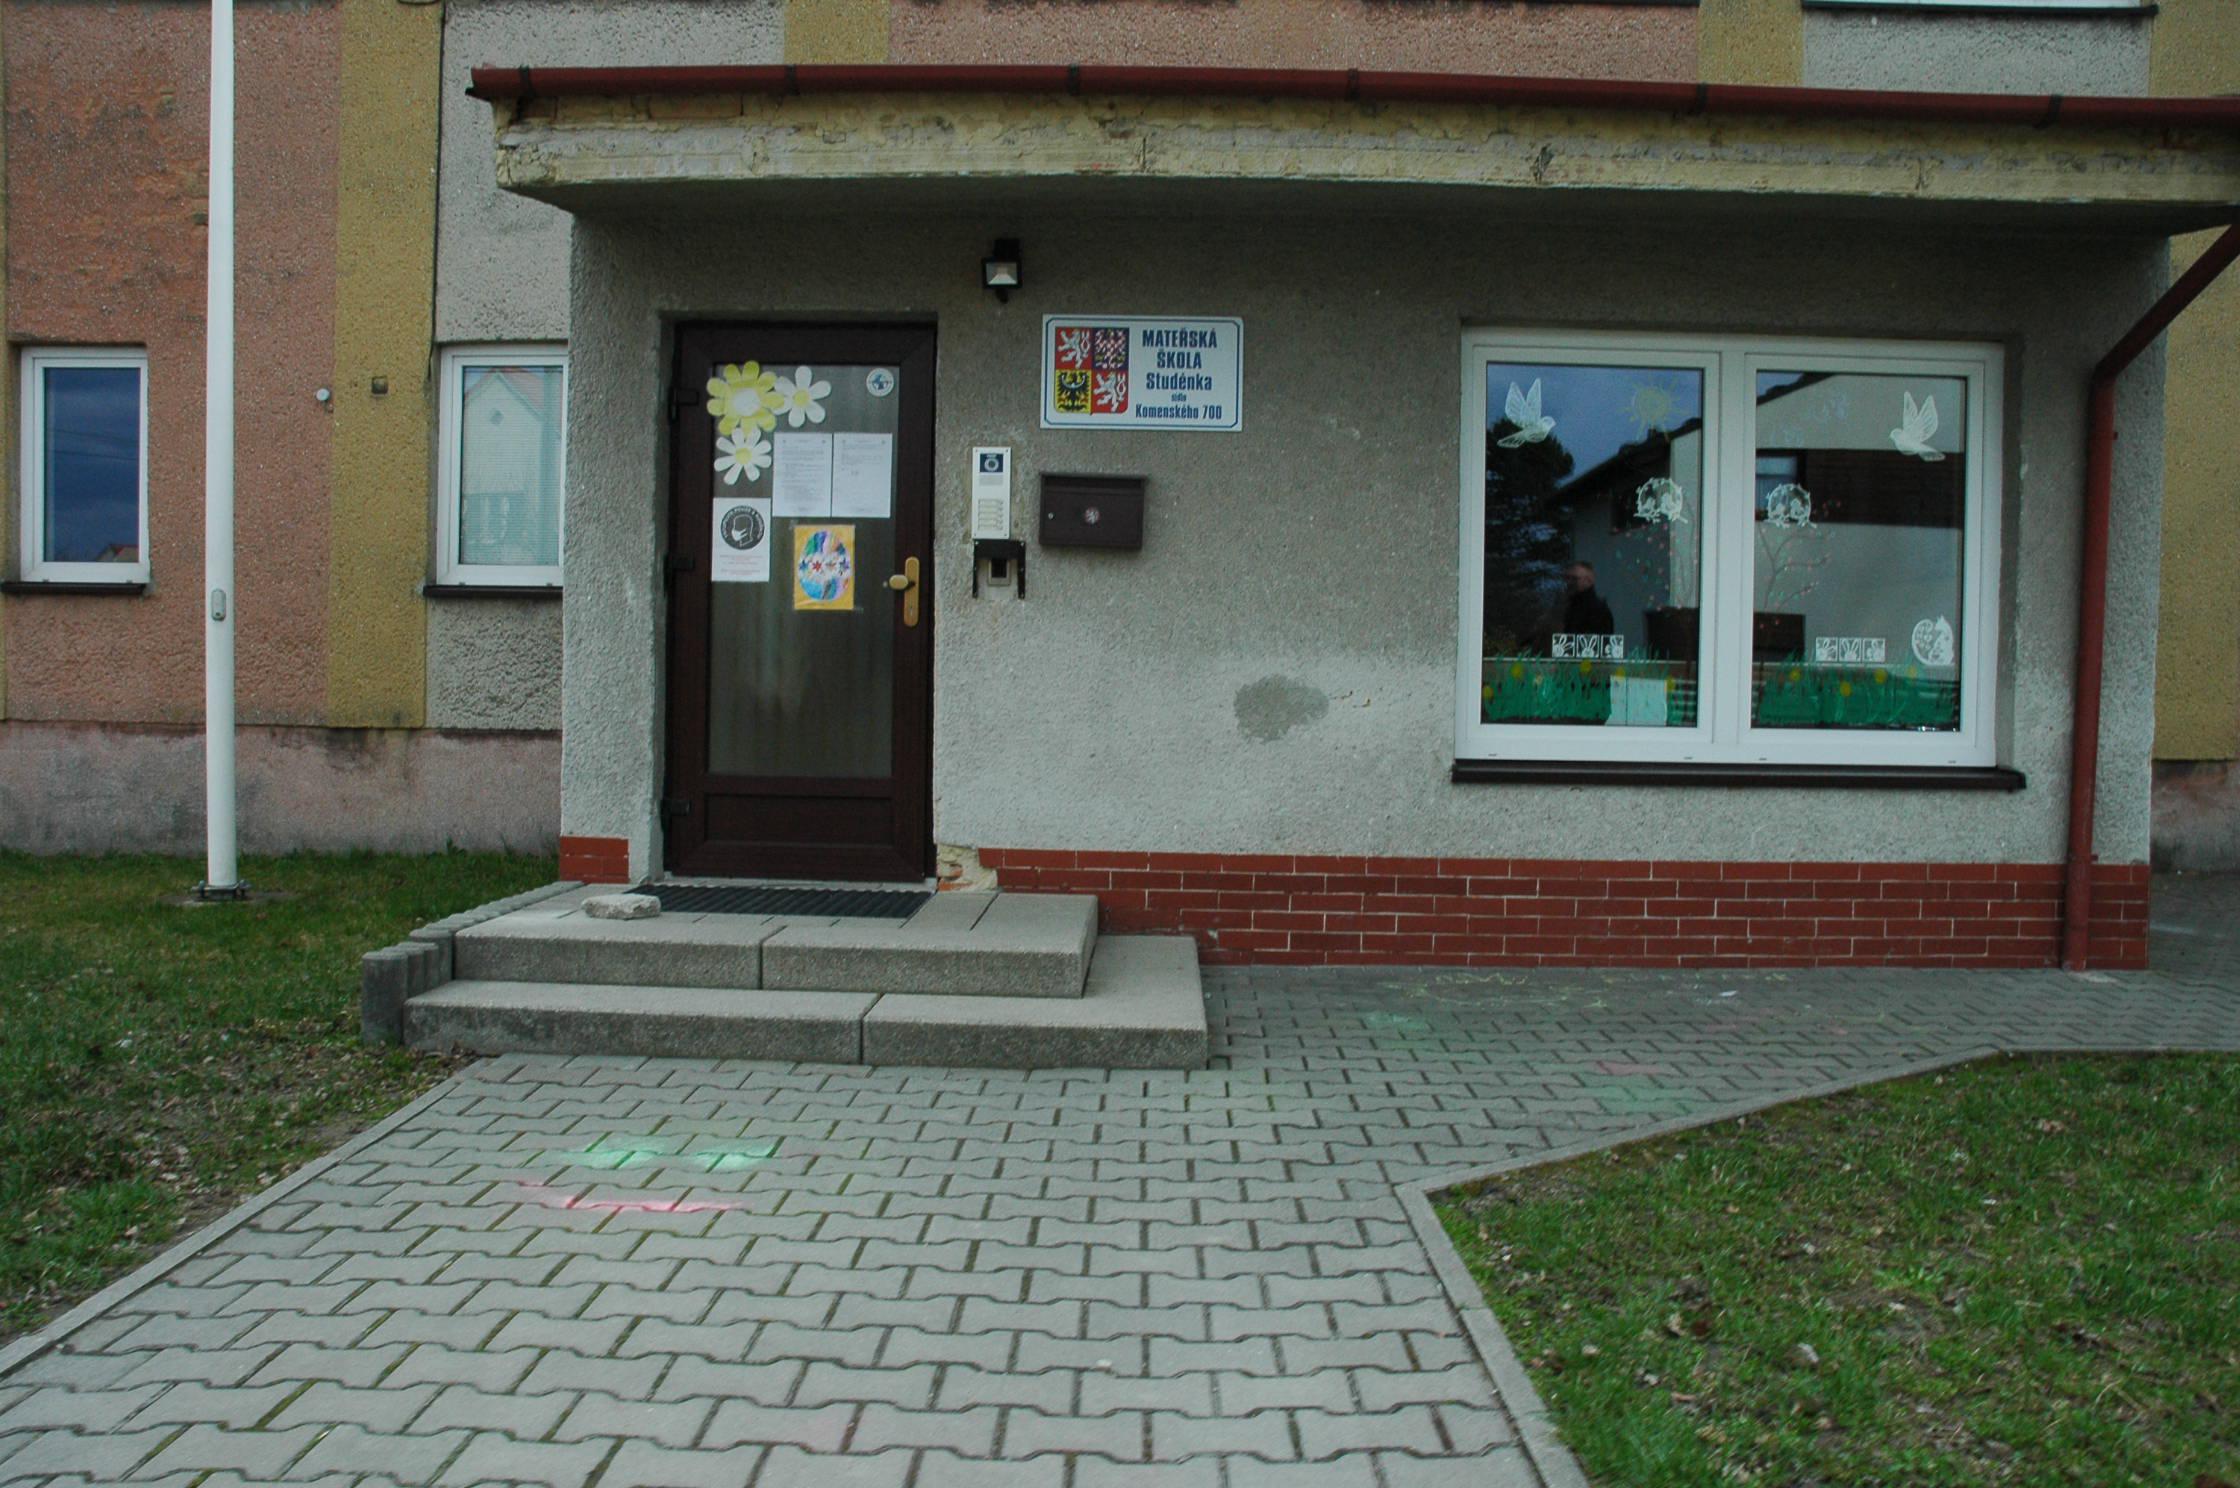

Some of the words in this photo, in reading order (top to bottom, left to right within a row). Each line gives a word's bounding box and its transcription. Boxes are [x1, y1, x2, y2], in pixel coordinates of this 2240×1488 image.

[1142, 328, 1217, 348] MATEŘSKÁ
[1157, 349, 1202, 369] ŠKOLA
[1146, 372, 1212, 390] Studénka
[1135, 403, 1199, 419] Komenského
[1202, 404, 1222, 419] 700
